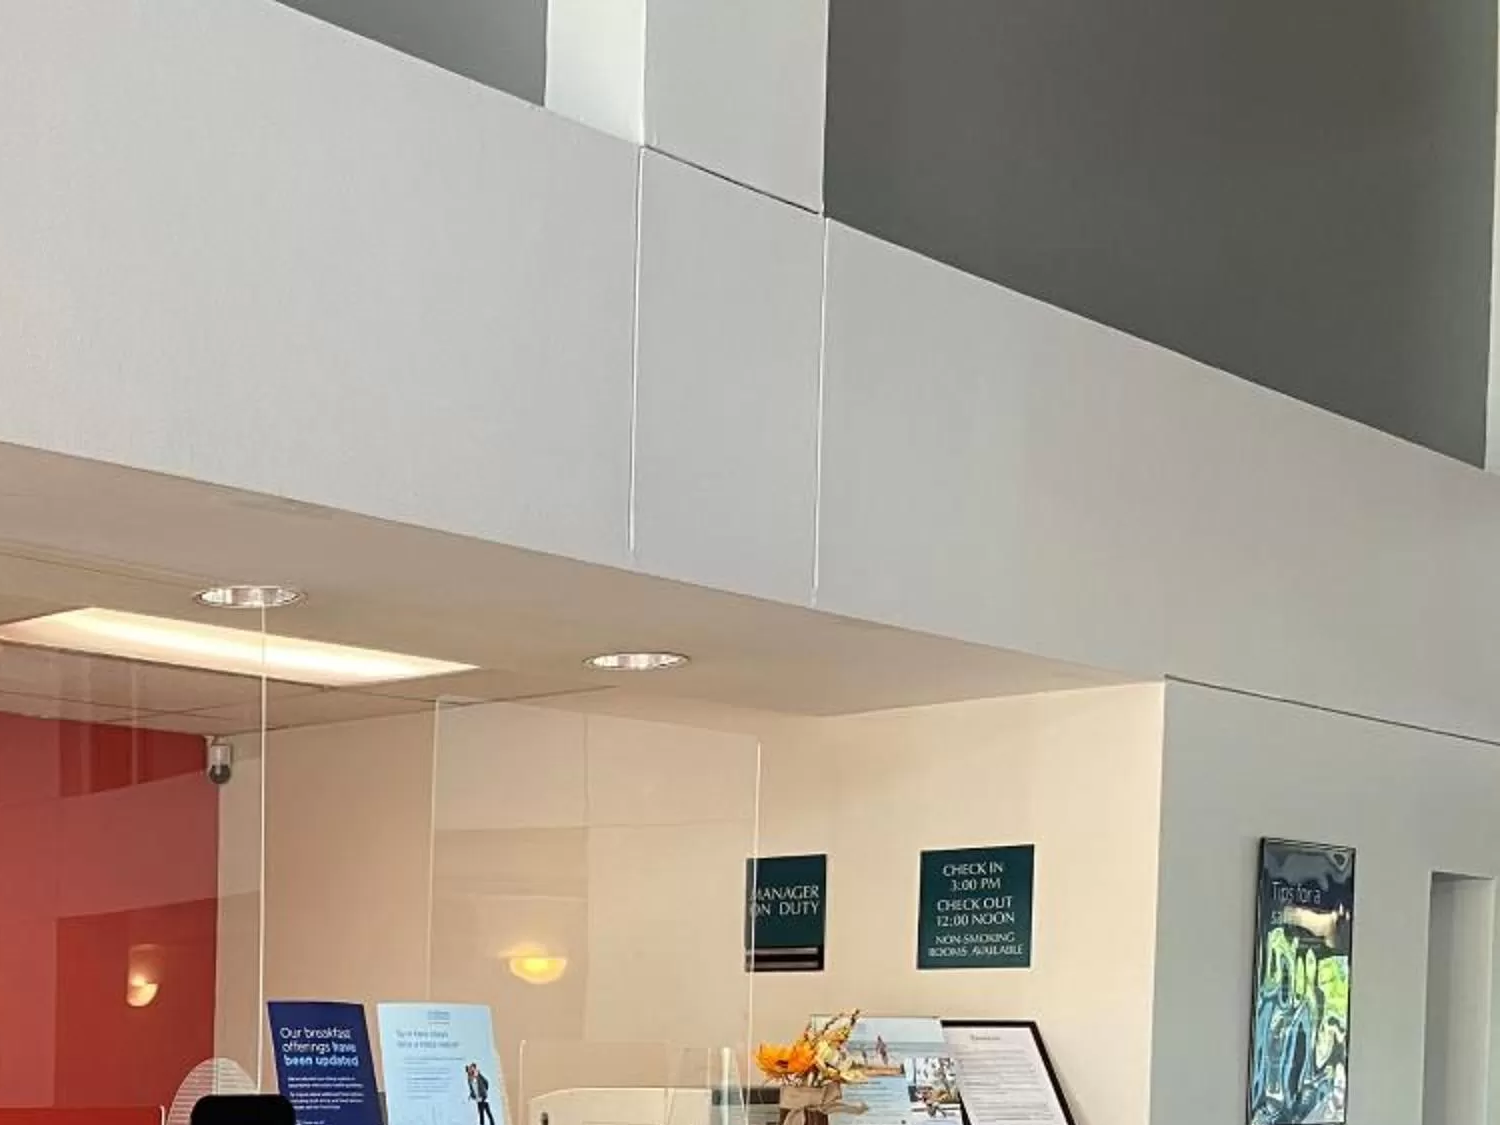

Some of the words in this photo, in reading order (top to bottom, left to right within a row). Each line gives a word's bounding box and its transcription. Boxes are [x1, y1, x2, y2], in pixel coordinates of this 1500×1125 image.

[943, 862, 987, 877] CHECK
[989, 861, 1004, 875] IN
[950, 879, 977, 892] 3:00
[981, 877, 1001, 889] PM
[1271, 881, 1294, 903] Tips
[779, 901, 819, 915] DUTY
[937, 898, 980, 912] CHECK
[983, 896, 1013, 909] OUT
[936, 914, 969, 927] 12:00
[971, 911, 1016, 925] NOON
[927, 945, 969, 957] ROOMS
[971, 943, 1025, 956] AVAILABLE
[279, 1027, 302, 1039] Our
[303, 1026, 353, 1040] breakfast
[282, 1041, 331, 1055] offerings
[331, 1041, 357, 1053] have
[283, 1054, 313, 1067] been
[315, 1054, 359, 1068] updated
